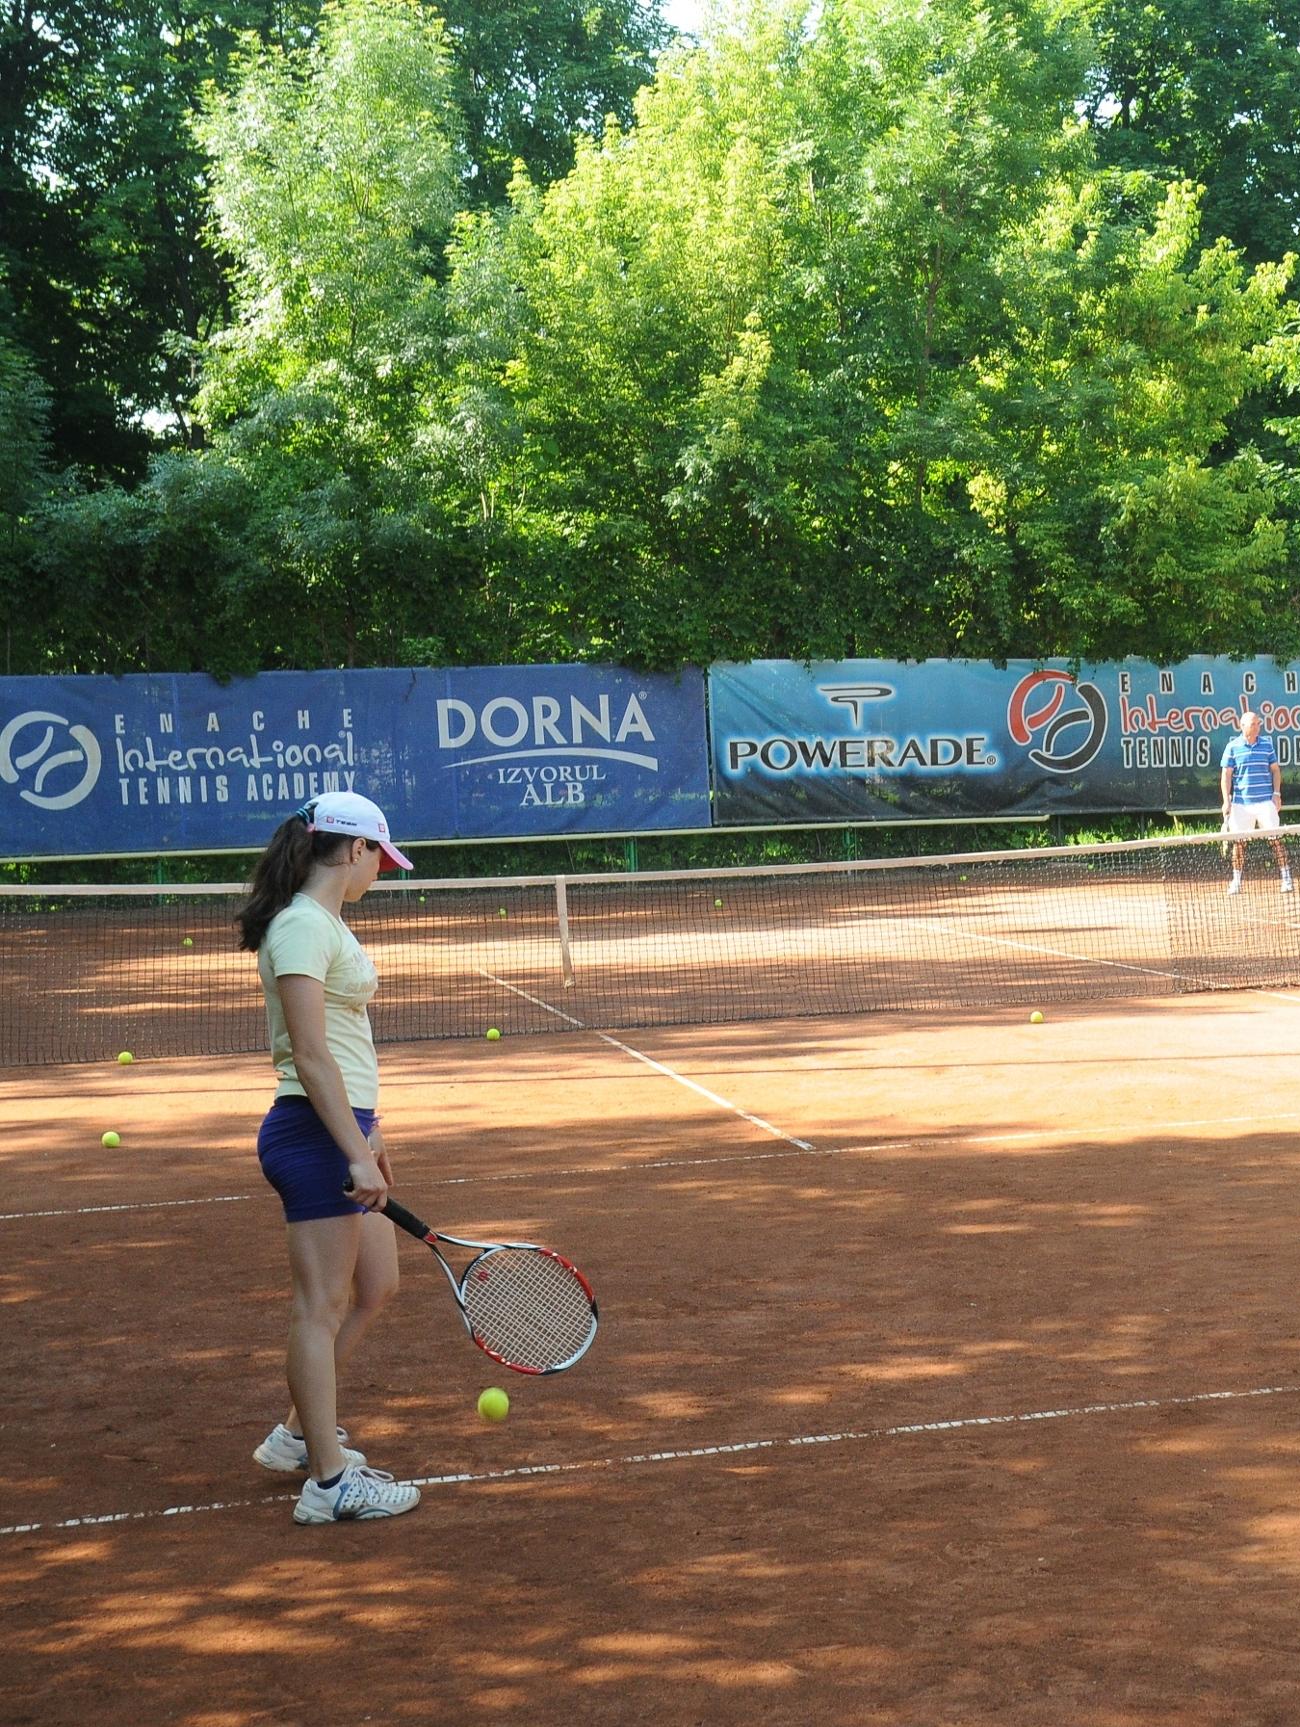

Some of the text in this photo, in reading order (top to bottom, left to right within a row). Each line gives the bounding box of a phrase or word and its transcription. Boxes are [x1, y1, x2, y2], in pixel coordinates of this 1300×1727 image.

[115, 708, 354, 735] ENACHE
[436, 693, 656, 748] DORNA
[116, 732, 355, 774] International
[729, 736, 988, 772] POWERADE
[1121, 736, 1212, 769] TENNIS
[119, 771, 356, 806] TENNIS ACADEMY
[498, 764, 607, 784] IZVORUL
[520, 782, 586, 806] ALB
